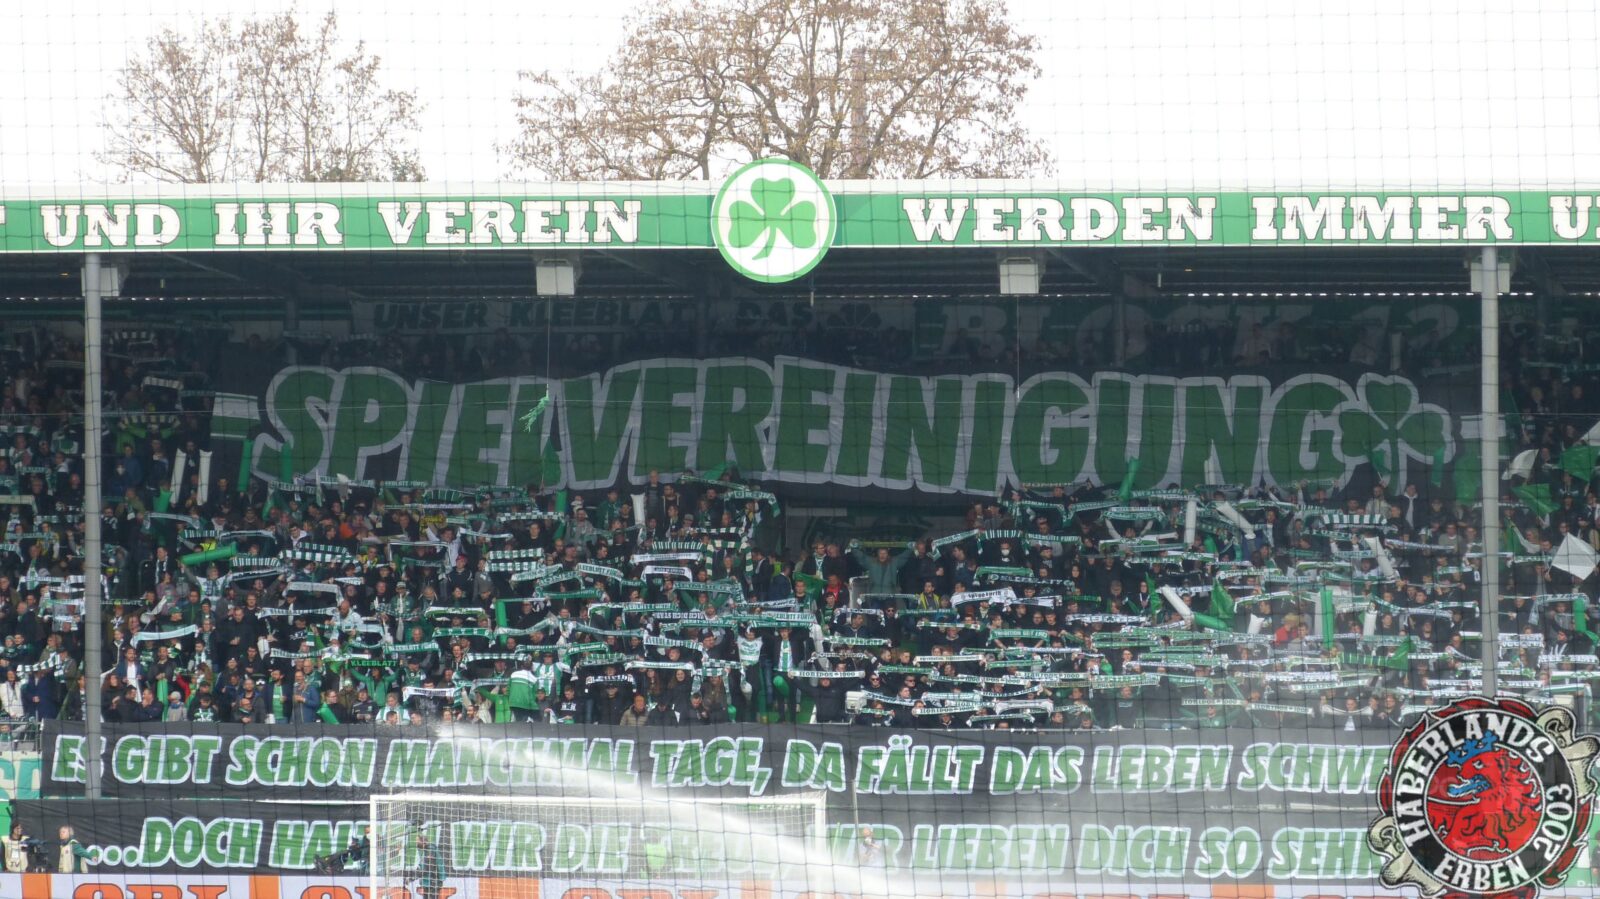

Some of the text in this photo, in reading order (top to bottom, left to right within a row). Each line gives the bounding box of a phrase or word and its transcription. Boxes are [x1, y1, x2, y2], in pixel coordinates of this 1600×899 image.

[40, 203, 181, 247] UND
[214, 202, 344, 246] IHR
[377, 199, 642, 246] VEREIN
[902, 195, 1600, 243] WERDEN IMMER U
[373, 300, 489, 330] UNSER
[735, 301, 814, 330] DAS
[252, 356, 1358, 496] SPIELVEREINIGUNG
[351, 659, 397, 667] KLEEBLATT
[112, 735, 220, 784] GIBT
[225, 737, 378, 787] SCHON
[382, 738, 639, 787] MANCHMAL
[649, 736, 773, 796] TAGE,
[781, 740, 848, 792] DA
[856, 734, 984, 795] FÄLLT
[989, 745, 1083, 796] DAS
[1089, 745, 1233, 794] LEBEN
[450, 820, 547, 873] WIR
[551, 823, 633, 873] DIE
[910, 823, 1071, 876] LIEBEN
[1076, 824, 1191, 877] DICH
[1194, 826, 1263, 879] SO
